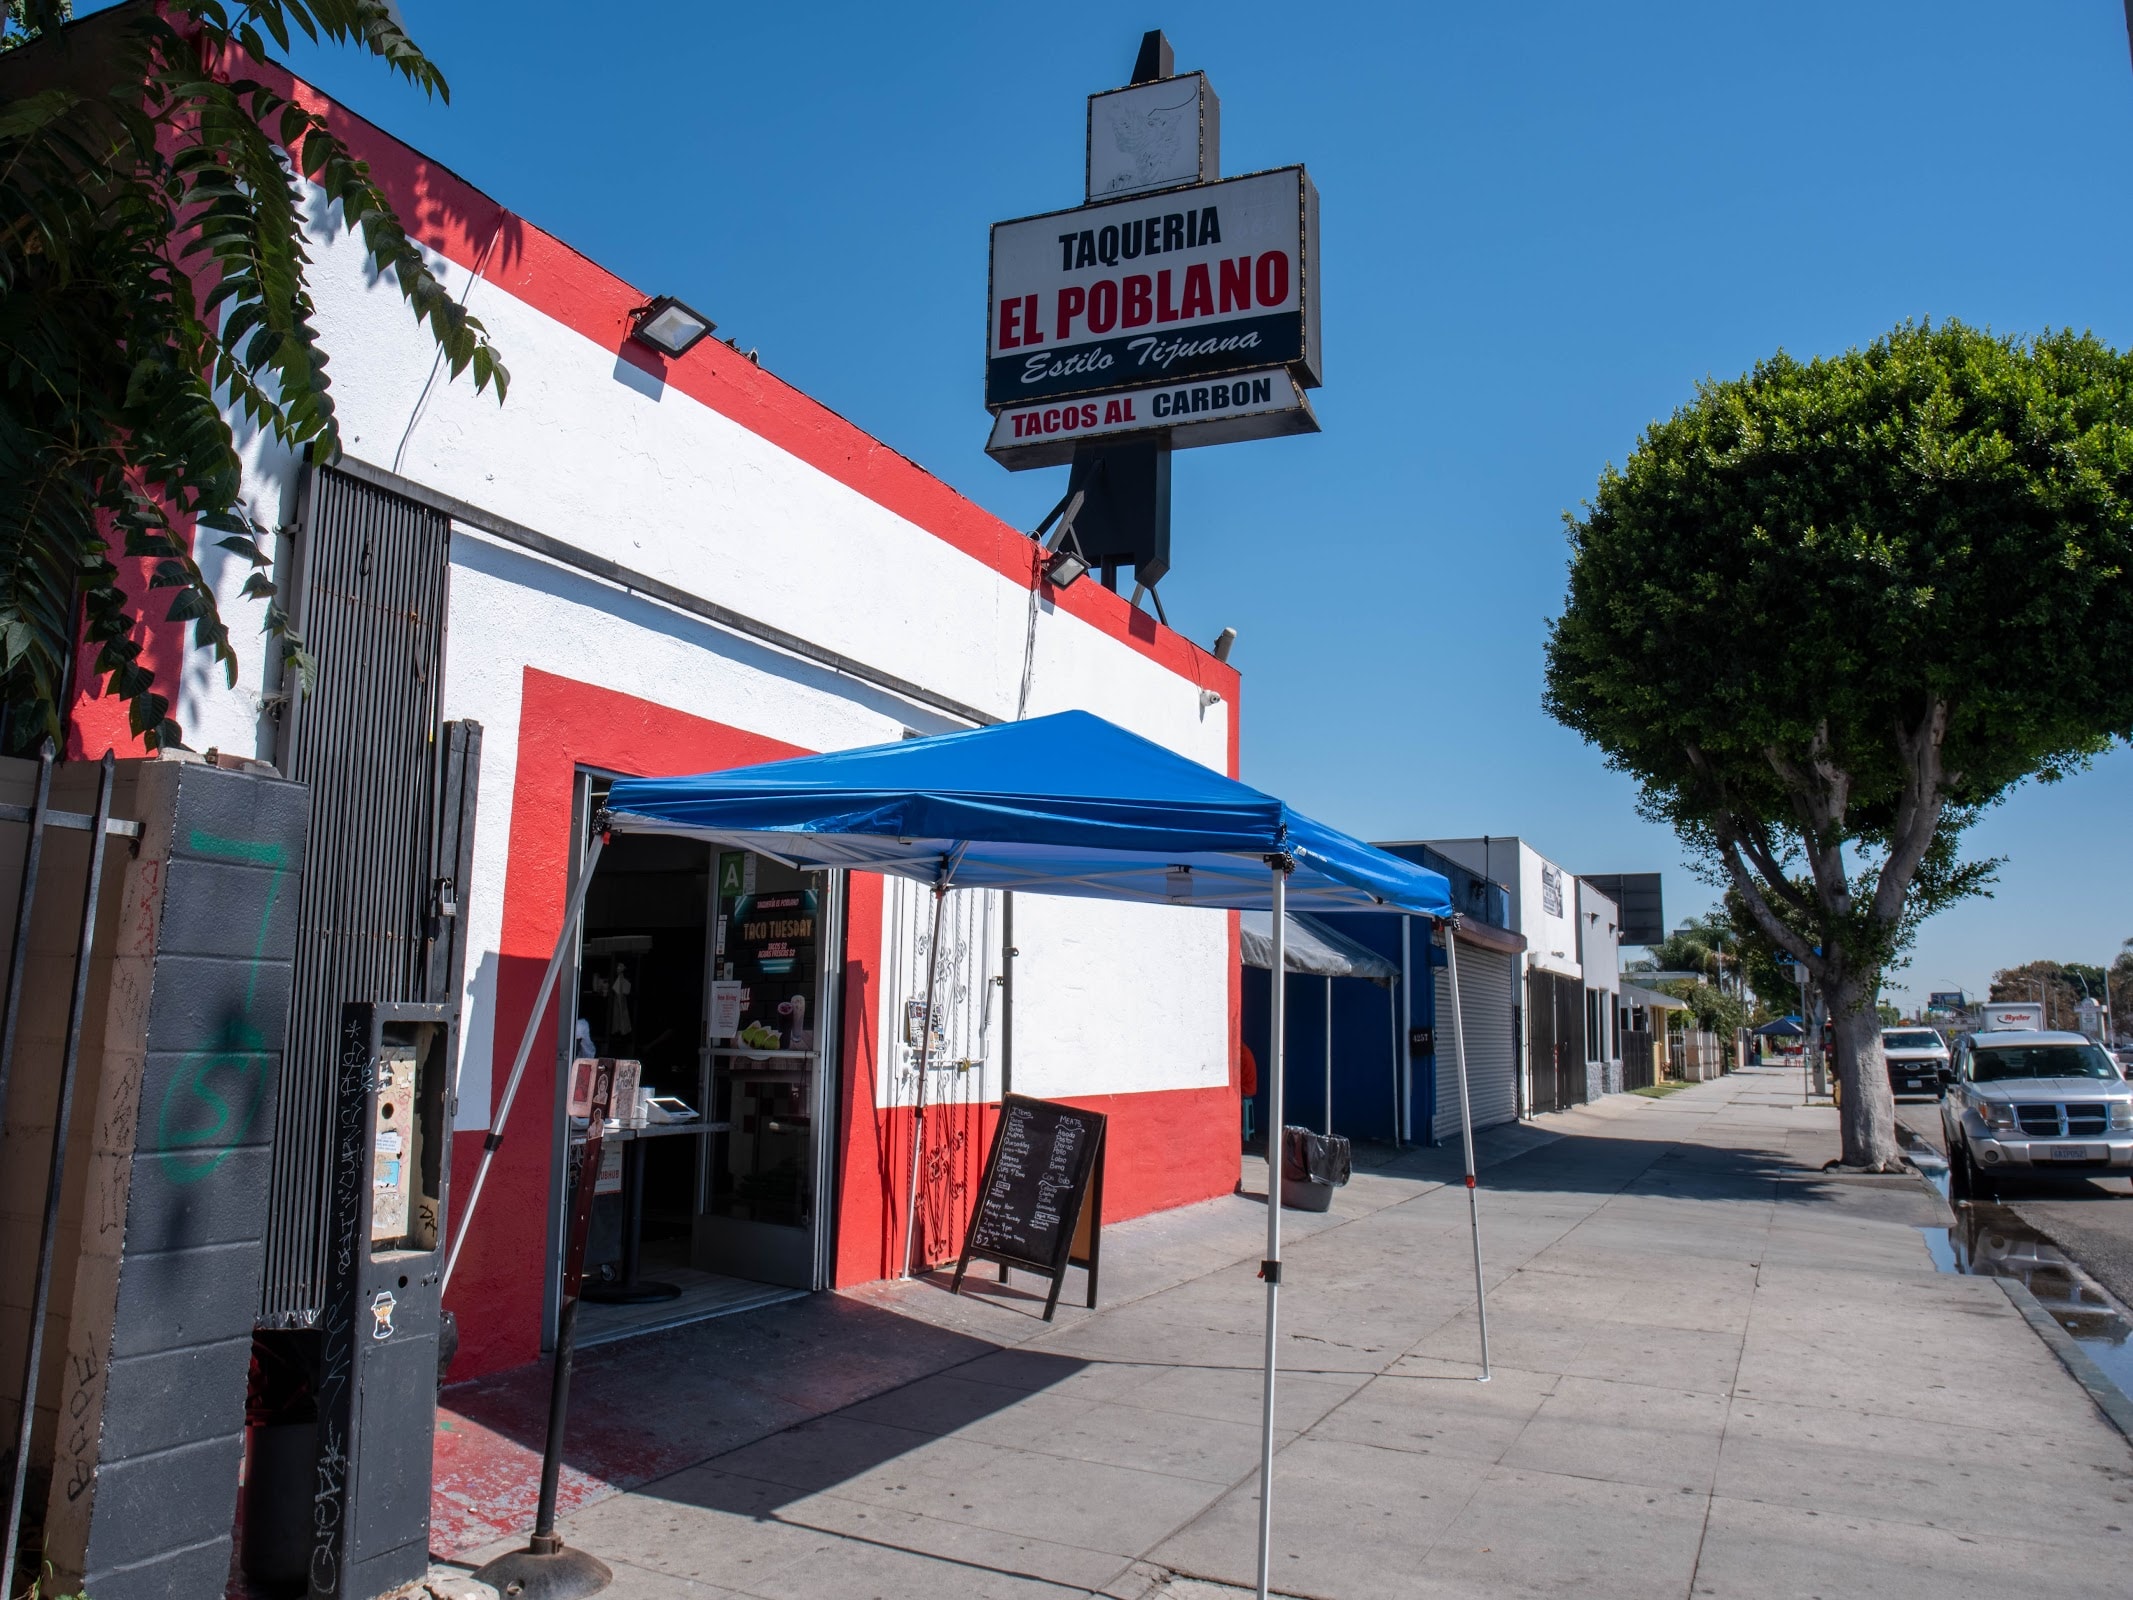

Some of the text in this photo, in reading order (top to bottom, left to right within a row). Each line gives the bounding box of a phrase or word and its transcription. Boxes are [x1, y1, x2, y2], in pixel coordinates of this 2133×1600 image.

[1058, 205, 1222, 272] TAQUERIA
[999, 250, 1289, 350] EL POBLANO
[1020, 330, 1262, 384] Estilo Tijuana
[1011, 377, 1271, 438] TACOS AL CARBON
[724, 863, 739, 888] A
[743, 922, 767, 940] TACO
[769, 918, 813, 938] TUESDAY
[2005, 1014, 2031, 1022] Ryder
[600, 1170, 620, 1180] UBHUB
